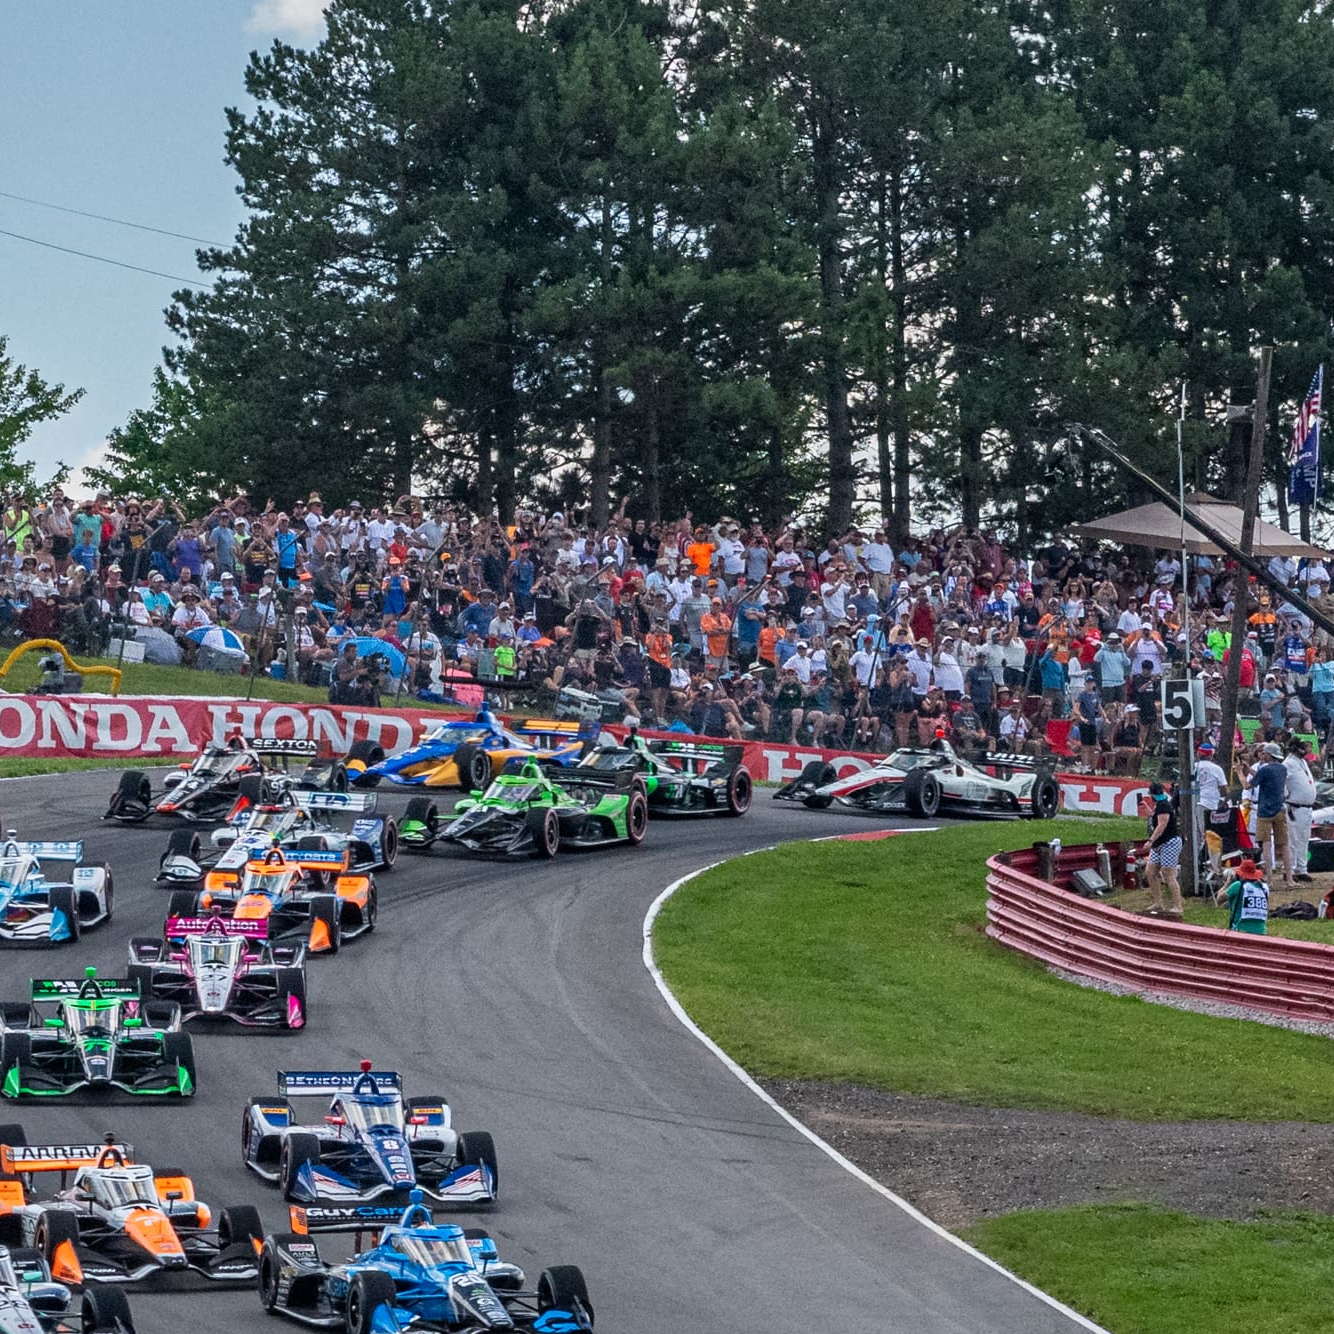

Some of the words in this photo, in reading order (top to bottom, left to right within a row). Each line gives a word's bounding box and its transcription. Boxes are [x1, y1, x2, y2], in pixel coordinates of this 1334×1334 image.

[1164, 680, 1192, 728] 5
[207, 704, 449, 758] HOND
[1247, 896, 1267, 909] 388
[383, 1139, 398, 1150] 8
